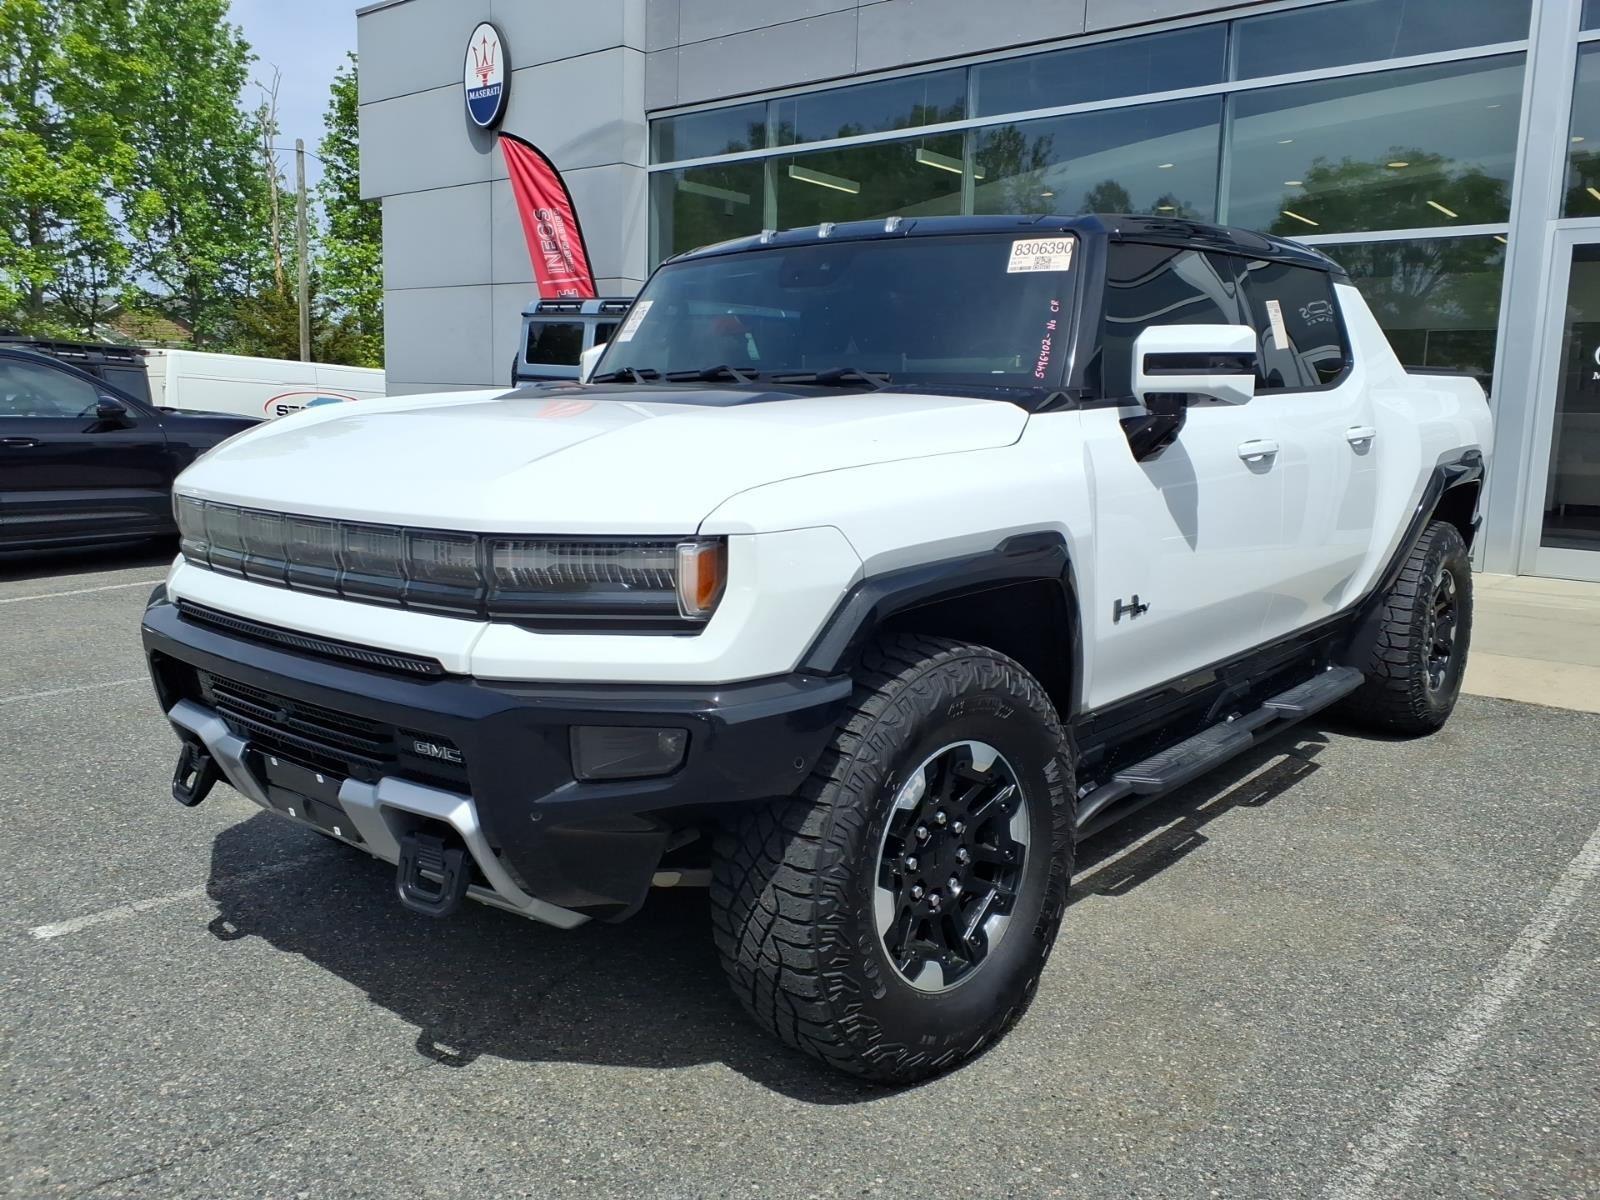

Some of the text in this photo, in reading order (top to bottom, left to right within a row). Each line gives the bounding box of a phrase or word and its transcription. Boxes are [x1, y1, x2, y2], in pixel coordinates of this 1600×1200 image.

[469, 86, 500, 100] MASERATI
[533, 208, 566, 274] INEOS
[1015, 241, 1073, 256] 8306390
[413, 740, 462, 763] GMC
